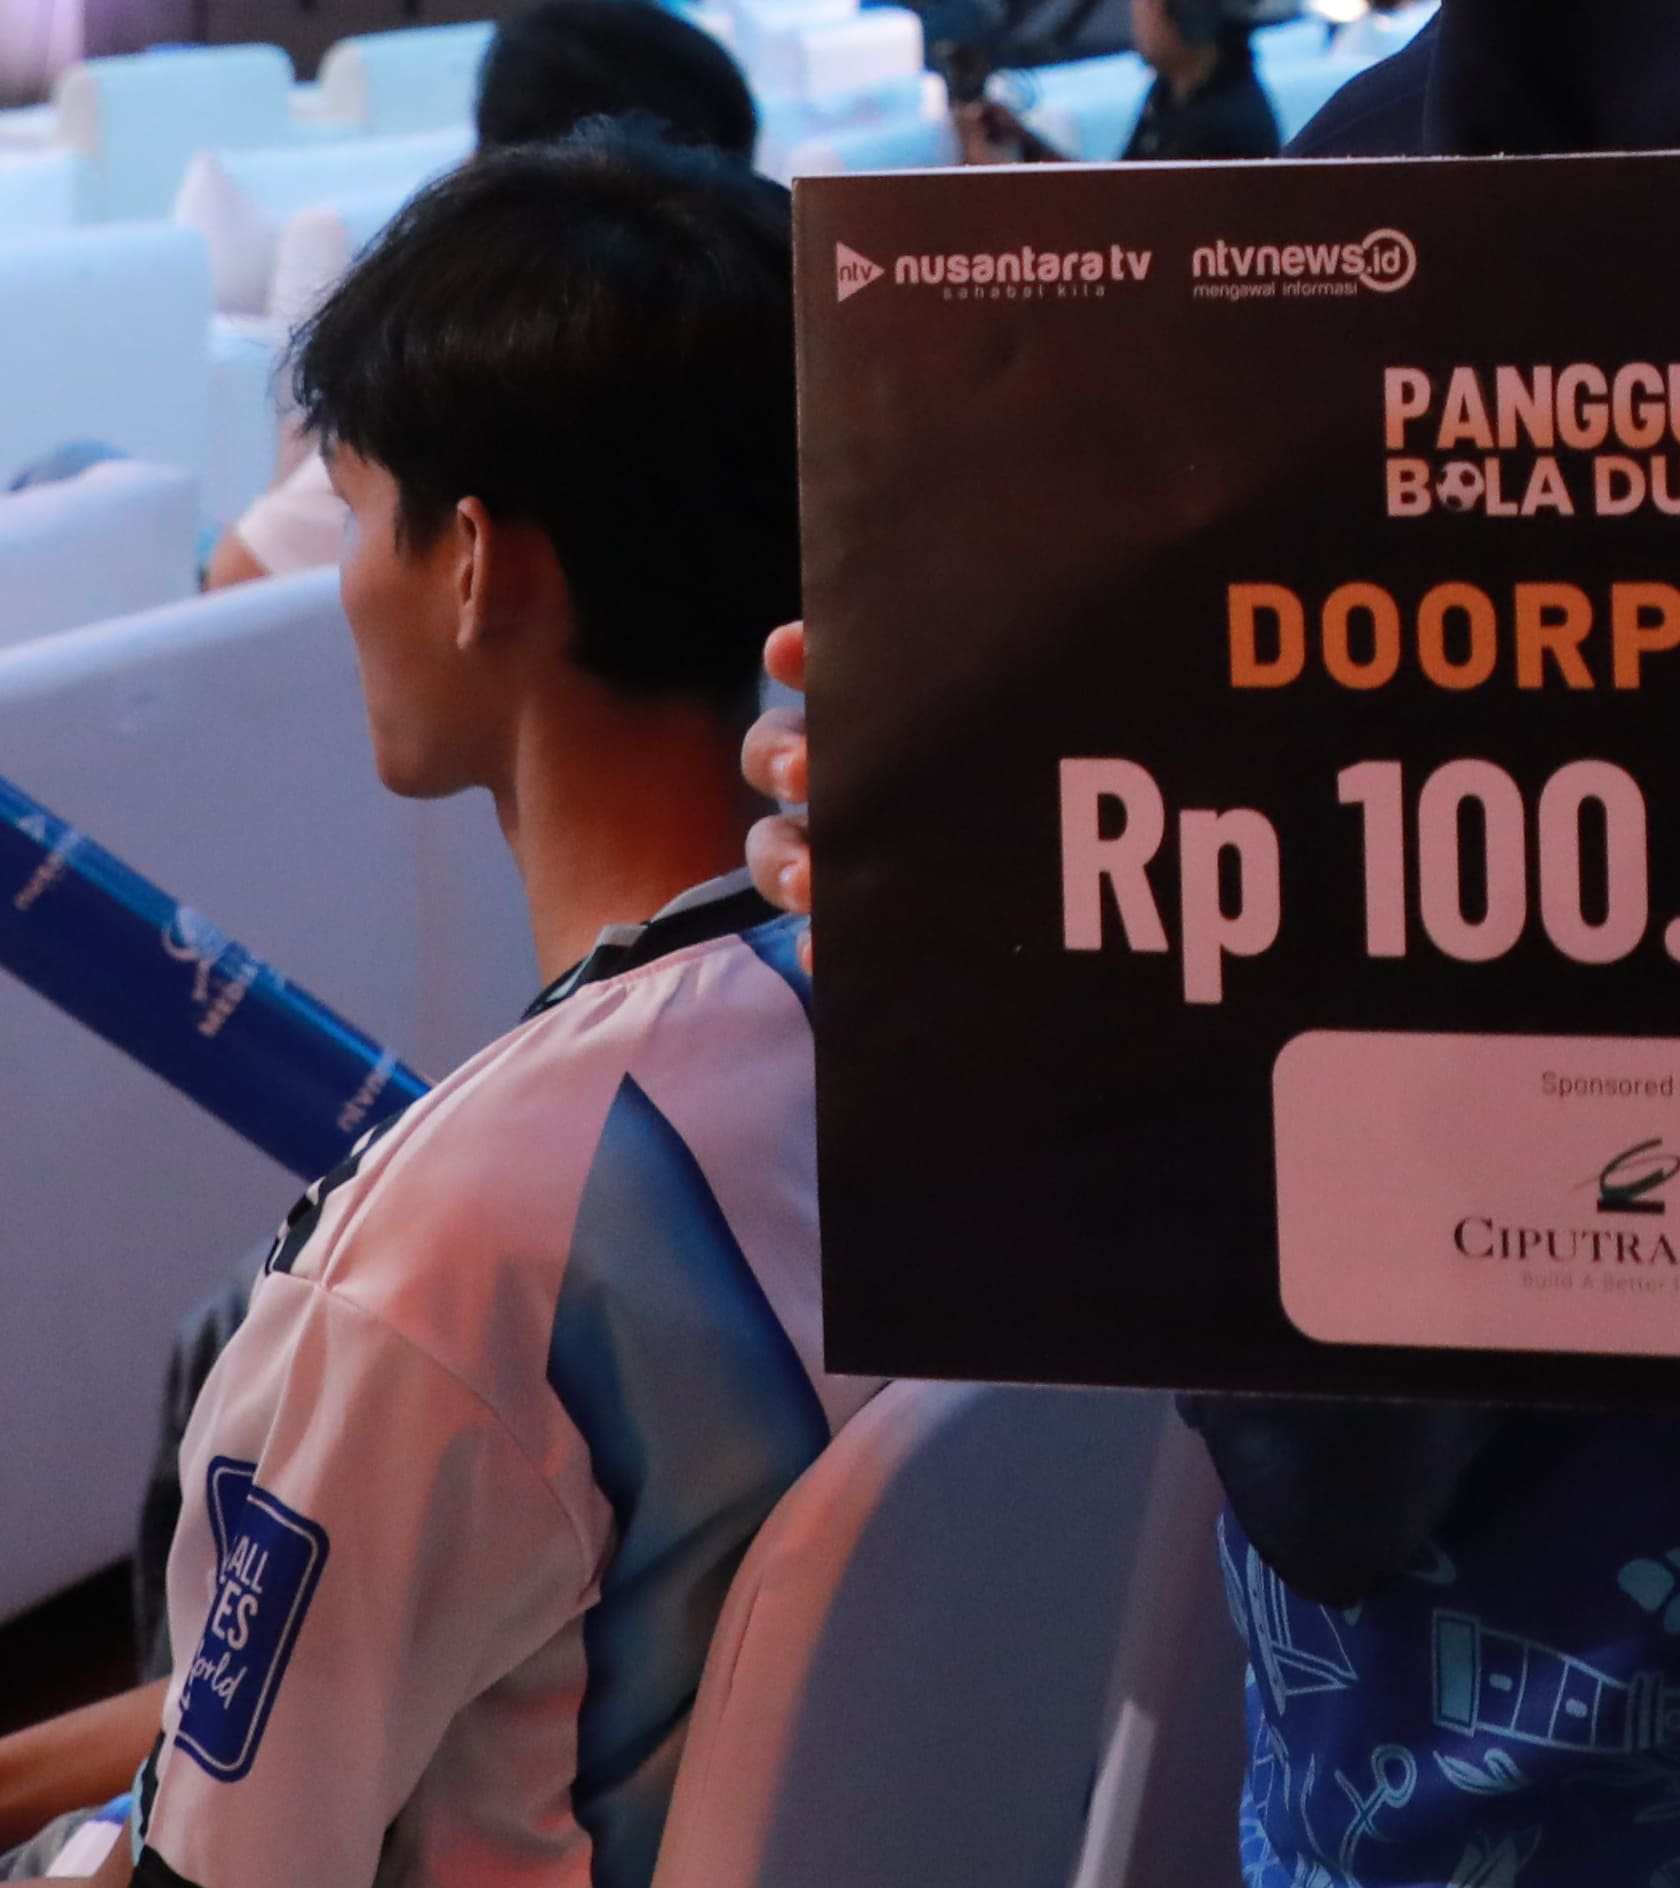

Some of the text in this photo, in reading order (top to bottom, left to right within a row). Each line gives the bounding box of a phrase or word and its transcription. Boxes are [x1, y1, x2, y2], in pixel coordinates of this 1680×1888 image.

[895, 243, 1153, 285] nusantara tv
[1192, 278, 1359, 302] mengawal informasi
[1059, 757, 1283, 1005] Rp
[1542, 1070, 1675, 1100] Sponsored
[1453, 1215, 1679, 1266] CIPUTRA
[190, 1651, 249, 1710] orld
